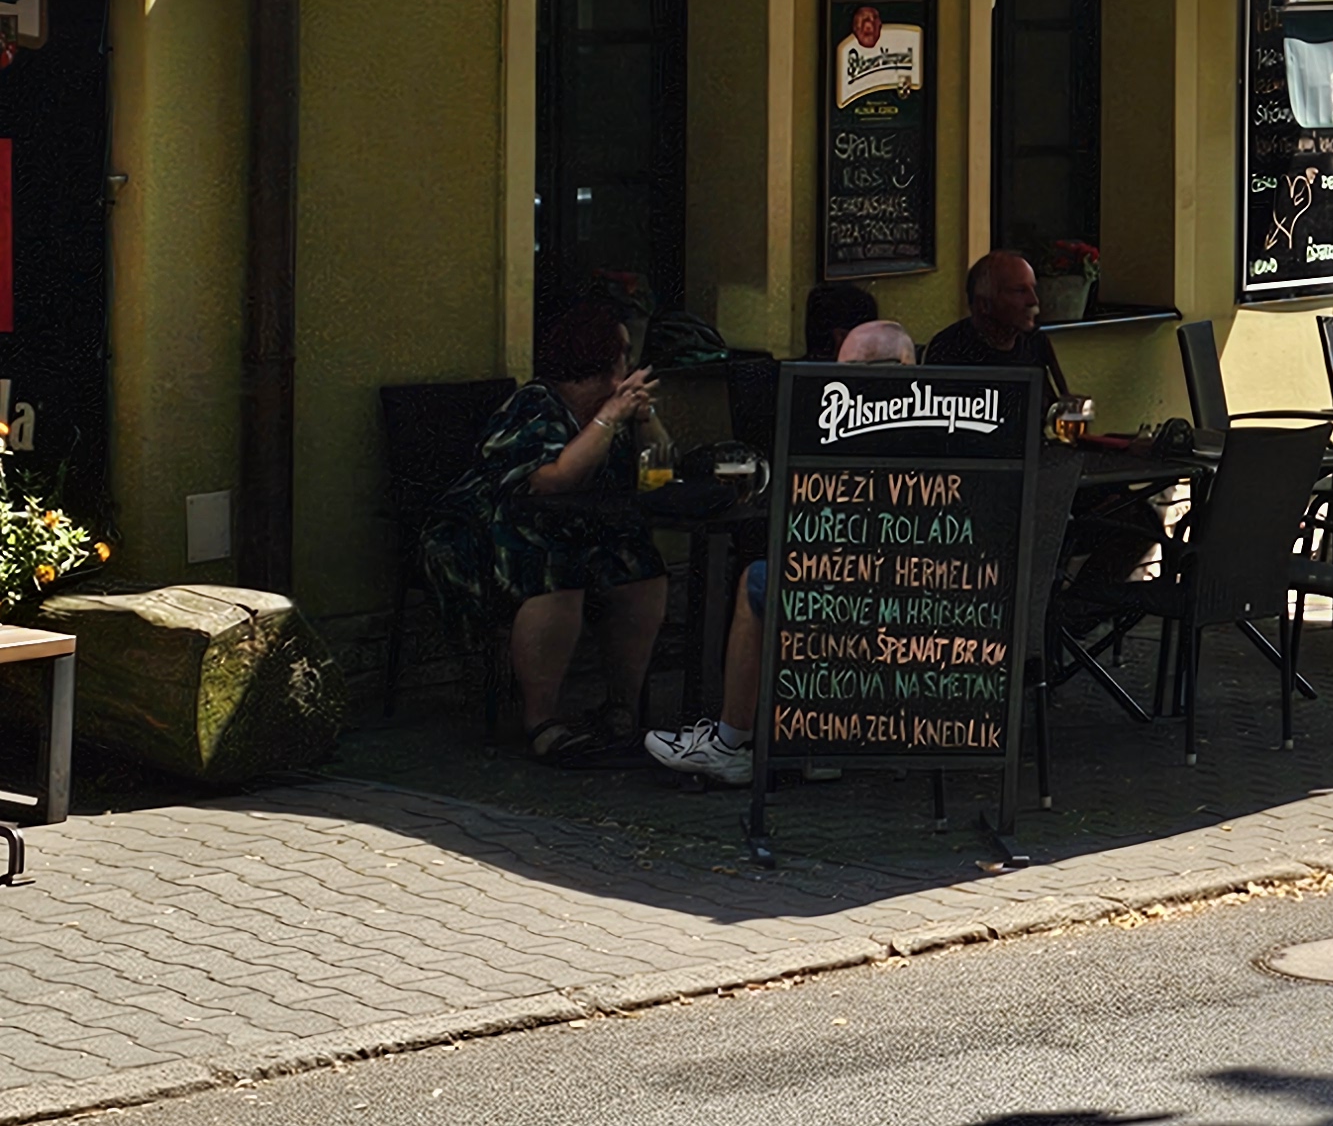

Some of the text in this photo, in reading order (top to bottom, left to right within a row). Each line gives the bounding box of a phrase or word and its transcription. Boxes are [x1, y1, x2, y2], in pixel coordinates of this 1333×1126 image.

[818, 380, 999, 445] Pilsner Urquell
[888, 471, 962, 507] VÝVAR
[878, 596, 900, 624] NA
[895, 670, 920, 699] NA
